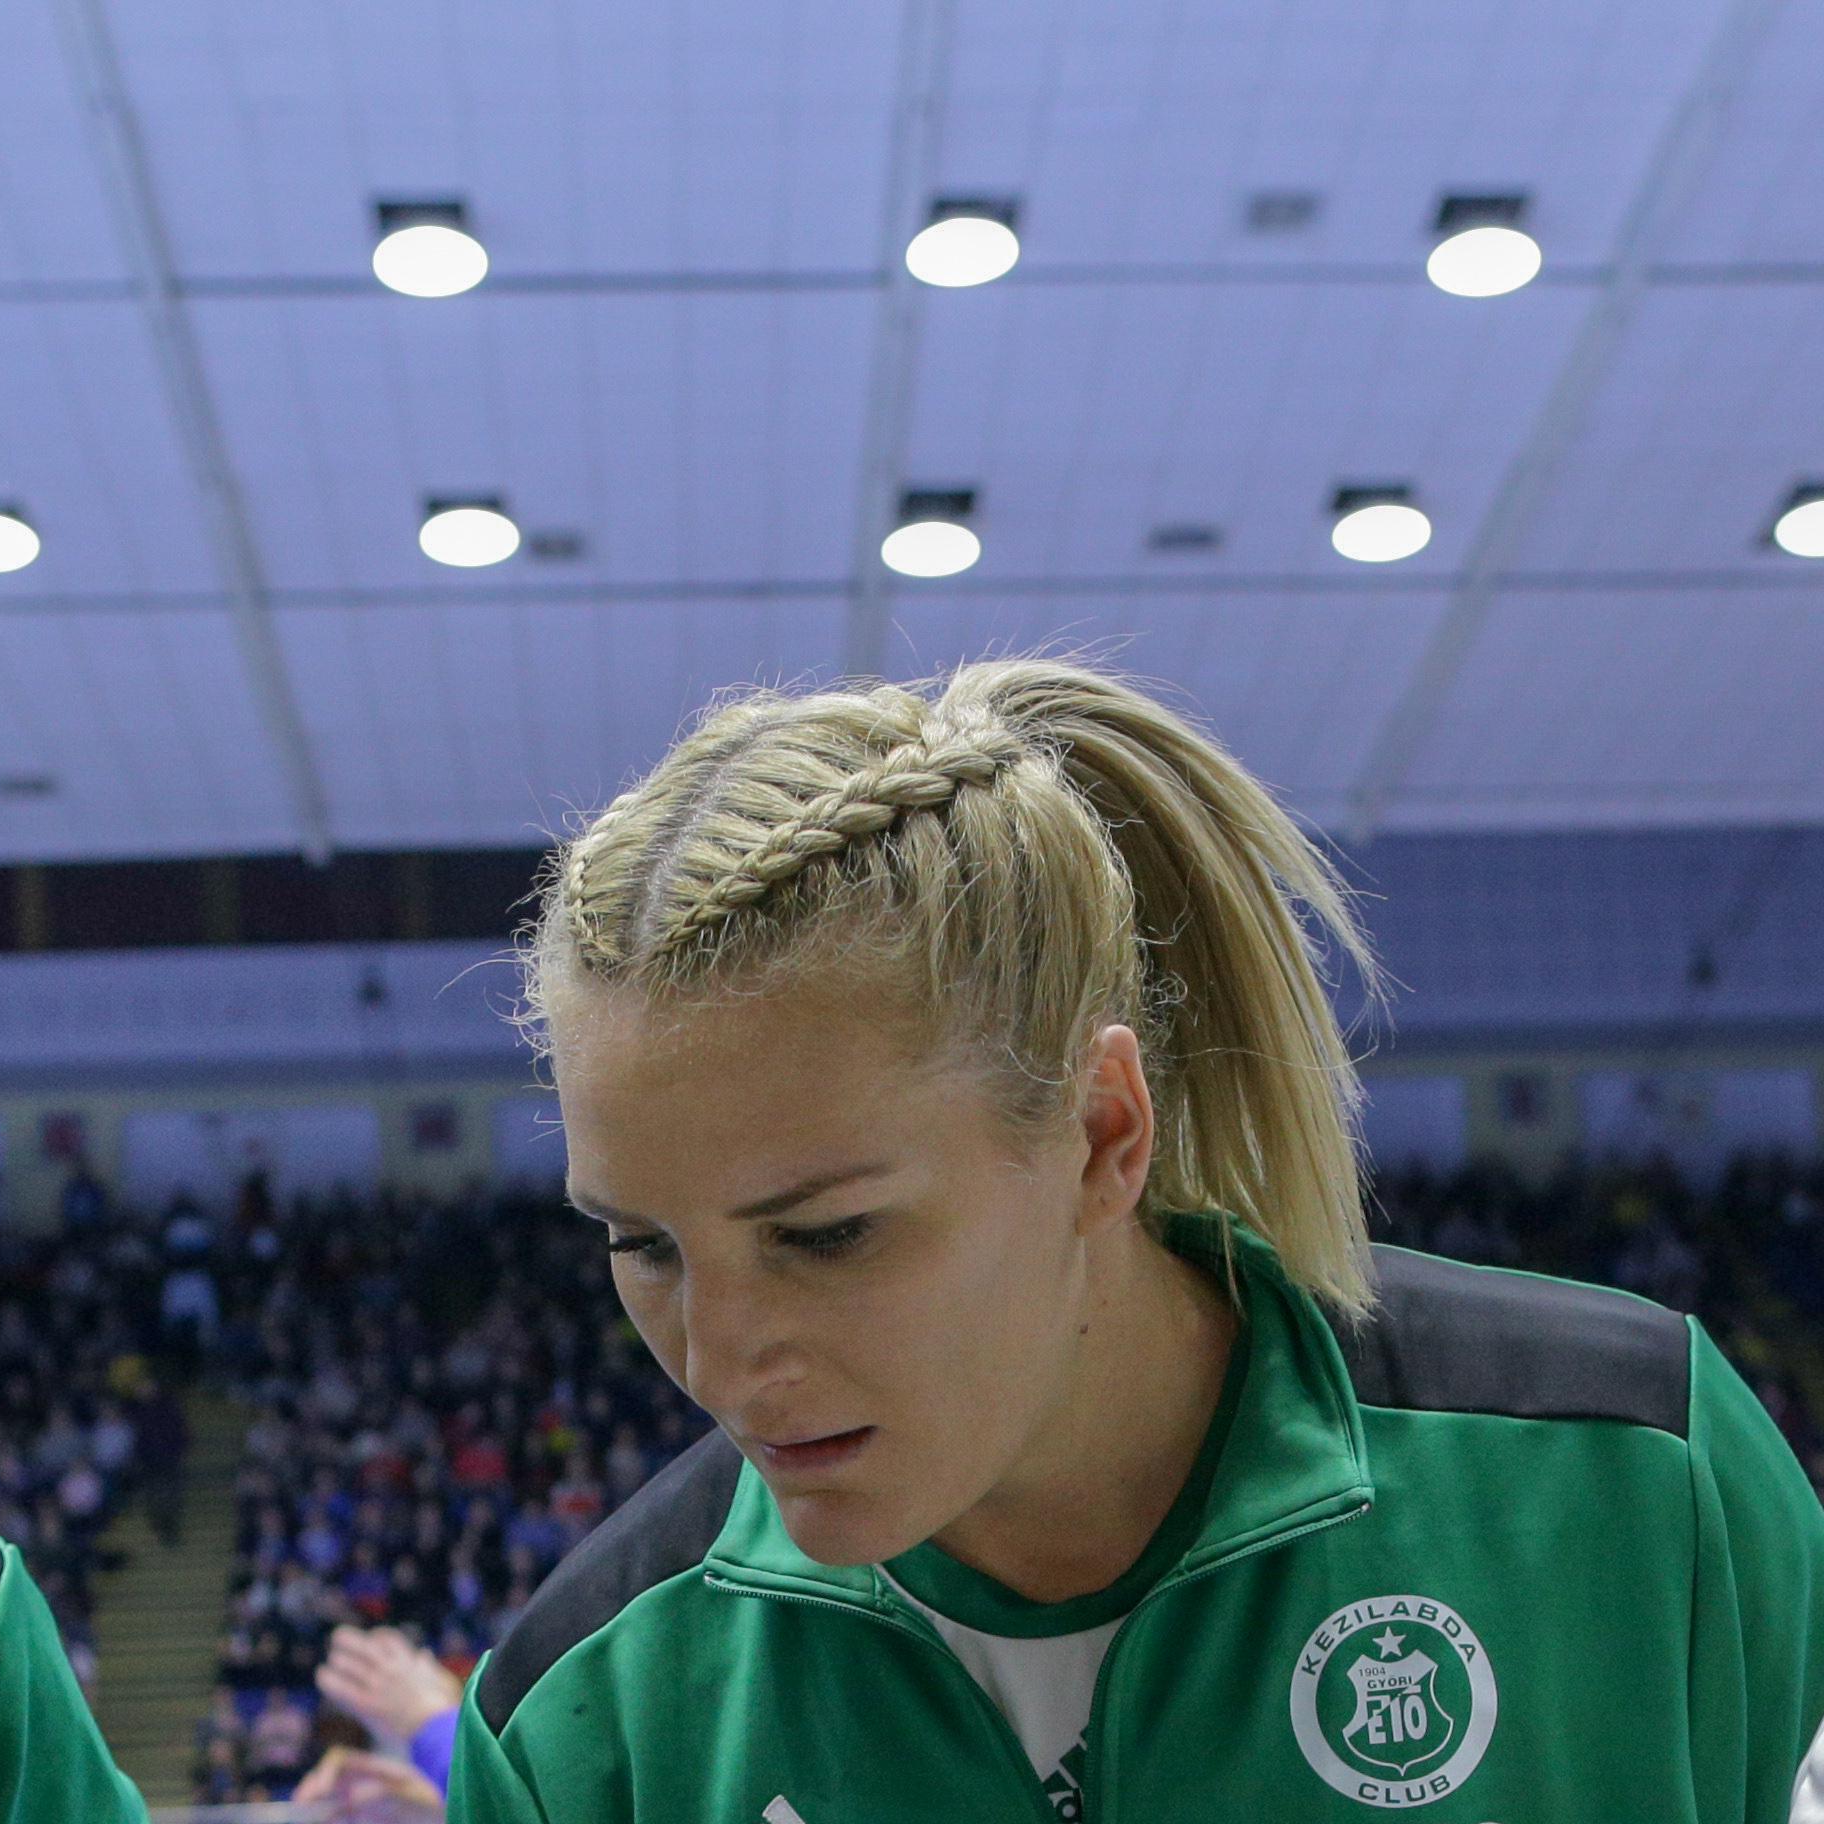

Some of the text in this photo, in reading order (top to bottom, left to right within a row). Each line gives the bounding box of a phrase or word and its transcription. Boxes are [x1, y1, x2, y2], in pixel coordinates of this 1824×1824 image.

[1301, 1601, 1477, 1676] KÉZILABDA
[1359, 1667, 1387, 1677] 1904
[1358, 1775, 1451, 1804] CLUB
